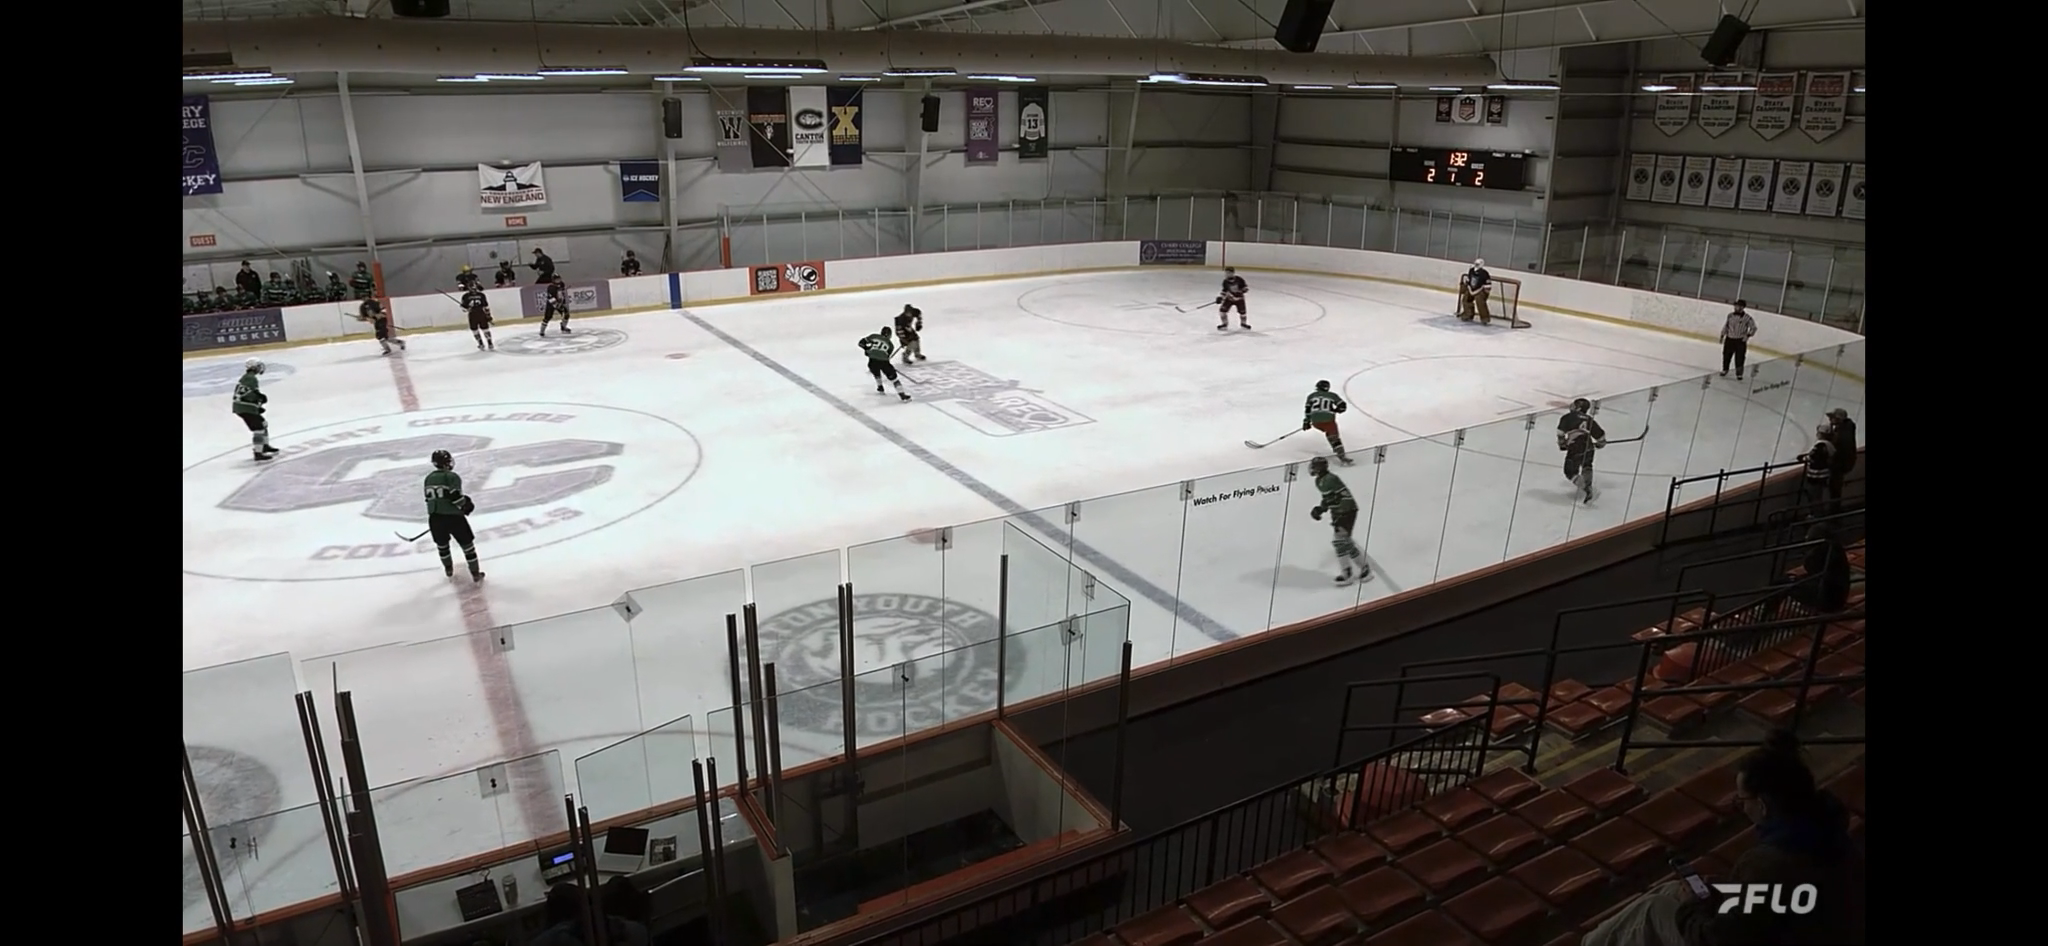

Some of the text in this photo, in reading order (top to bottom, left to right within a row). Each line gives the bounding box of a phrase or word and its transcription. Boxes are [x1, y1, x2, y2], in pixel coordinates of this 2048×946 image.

[718, 115, 744, 141] W
[831, 106, 859, 136] X
[1027, 118, 1039, 129] 13
[1450, 152, 1468, 167] 1:32
[1427, 168, 1436, 182] 2
[1475, 171, 1484, 185] 2
[481, 195, 501, 204] NEW
[502, 192, 544, 205] ENGLAND
[216, 331, 280, 343] HOCKEY
[1311, 398, 1331, 411] 20
[407, 411, 578, 428] COLLEGE
[1193, 494, 1217, 507] Watch
[1219, 493, 1231, 501] For
[1233, 487, 1255, 499] Flying
